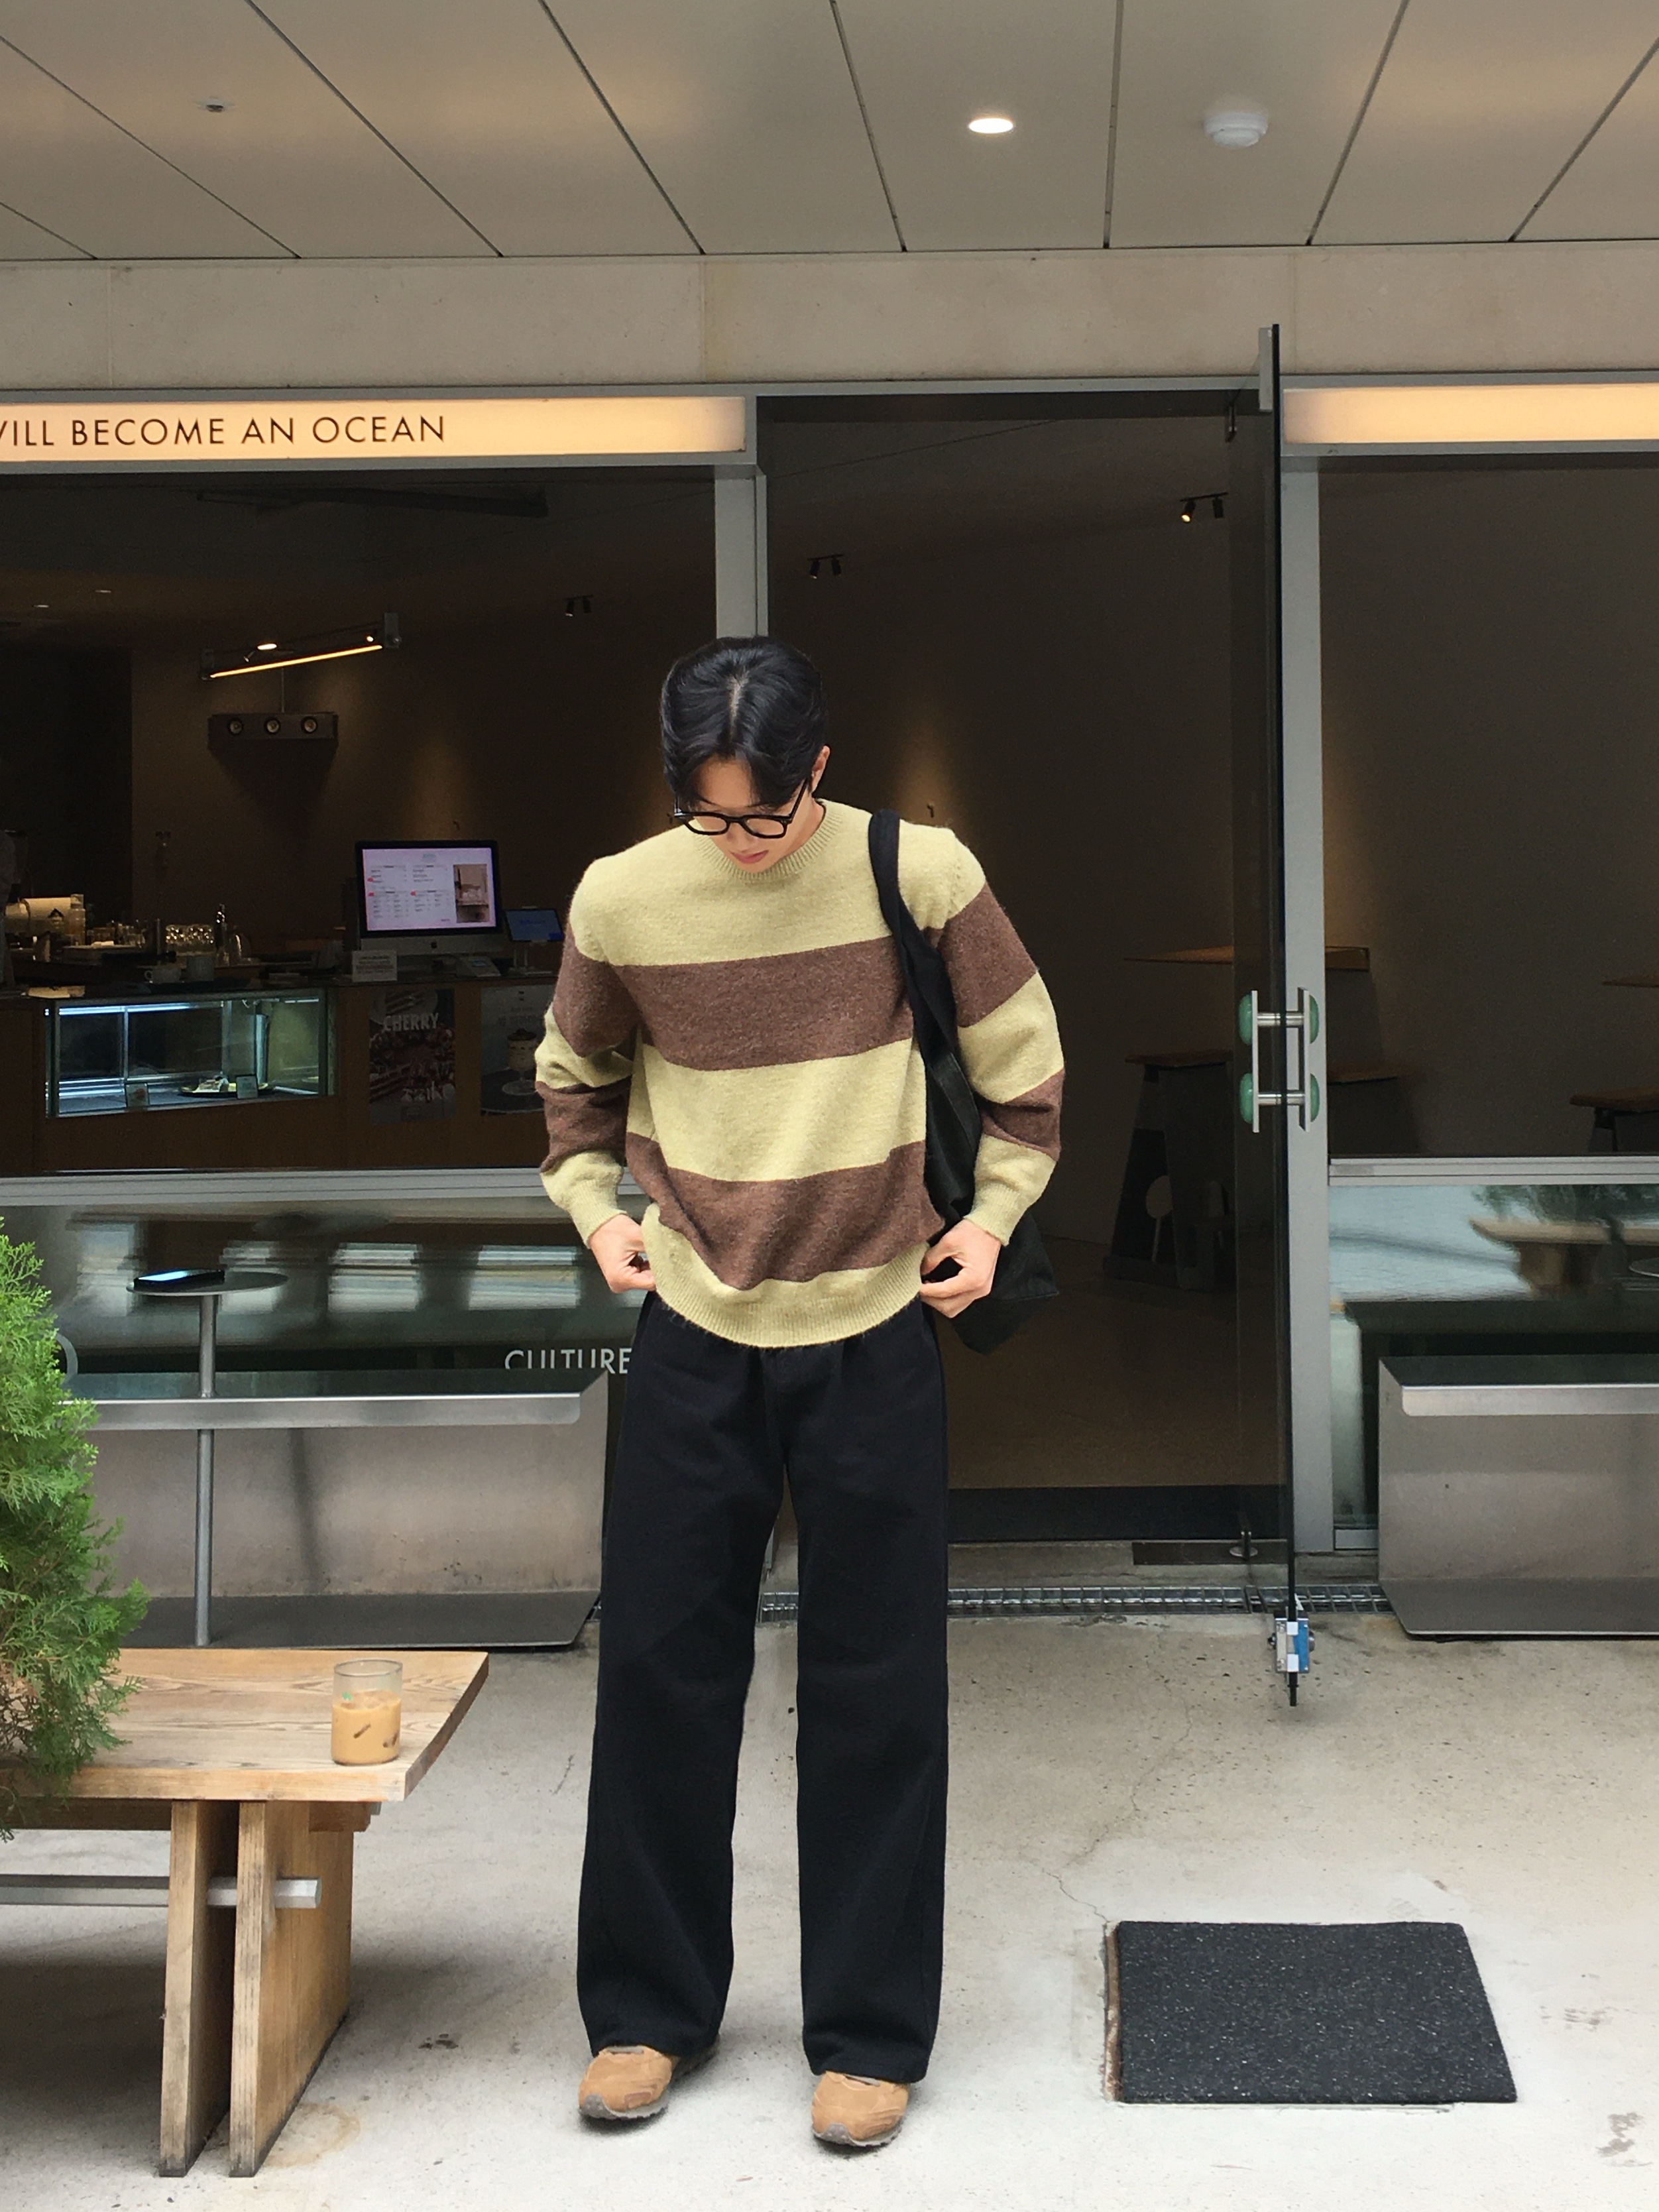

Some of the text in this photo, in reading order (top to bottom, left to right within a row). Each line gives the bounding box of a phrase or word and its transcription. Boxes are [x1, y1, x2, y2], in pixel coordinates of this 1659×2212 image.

[0, 416, 443, 446] ILL BECOME AN OCEAN
[382, 1012, 439, 1031] CHERRY
